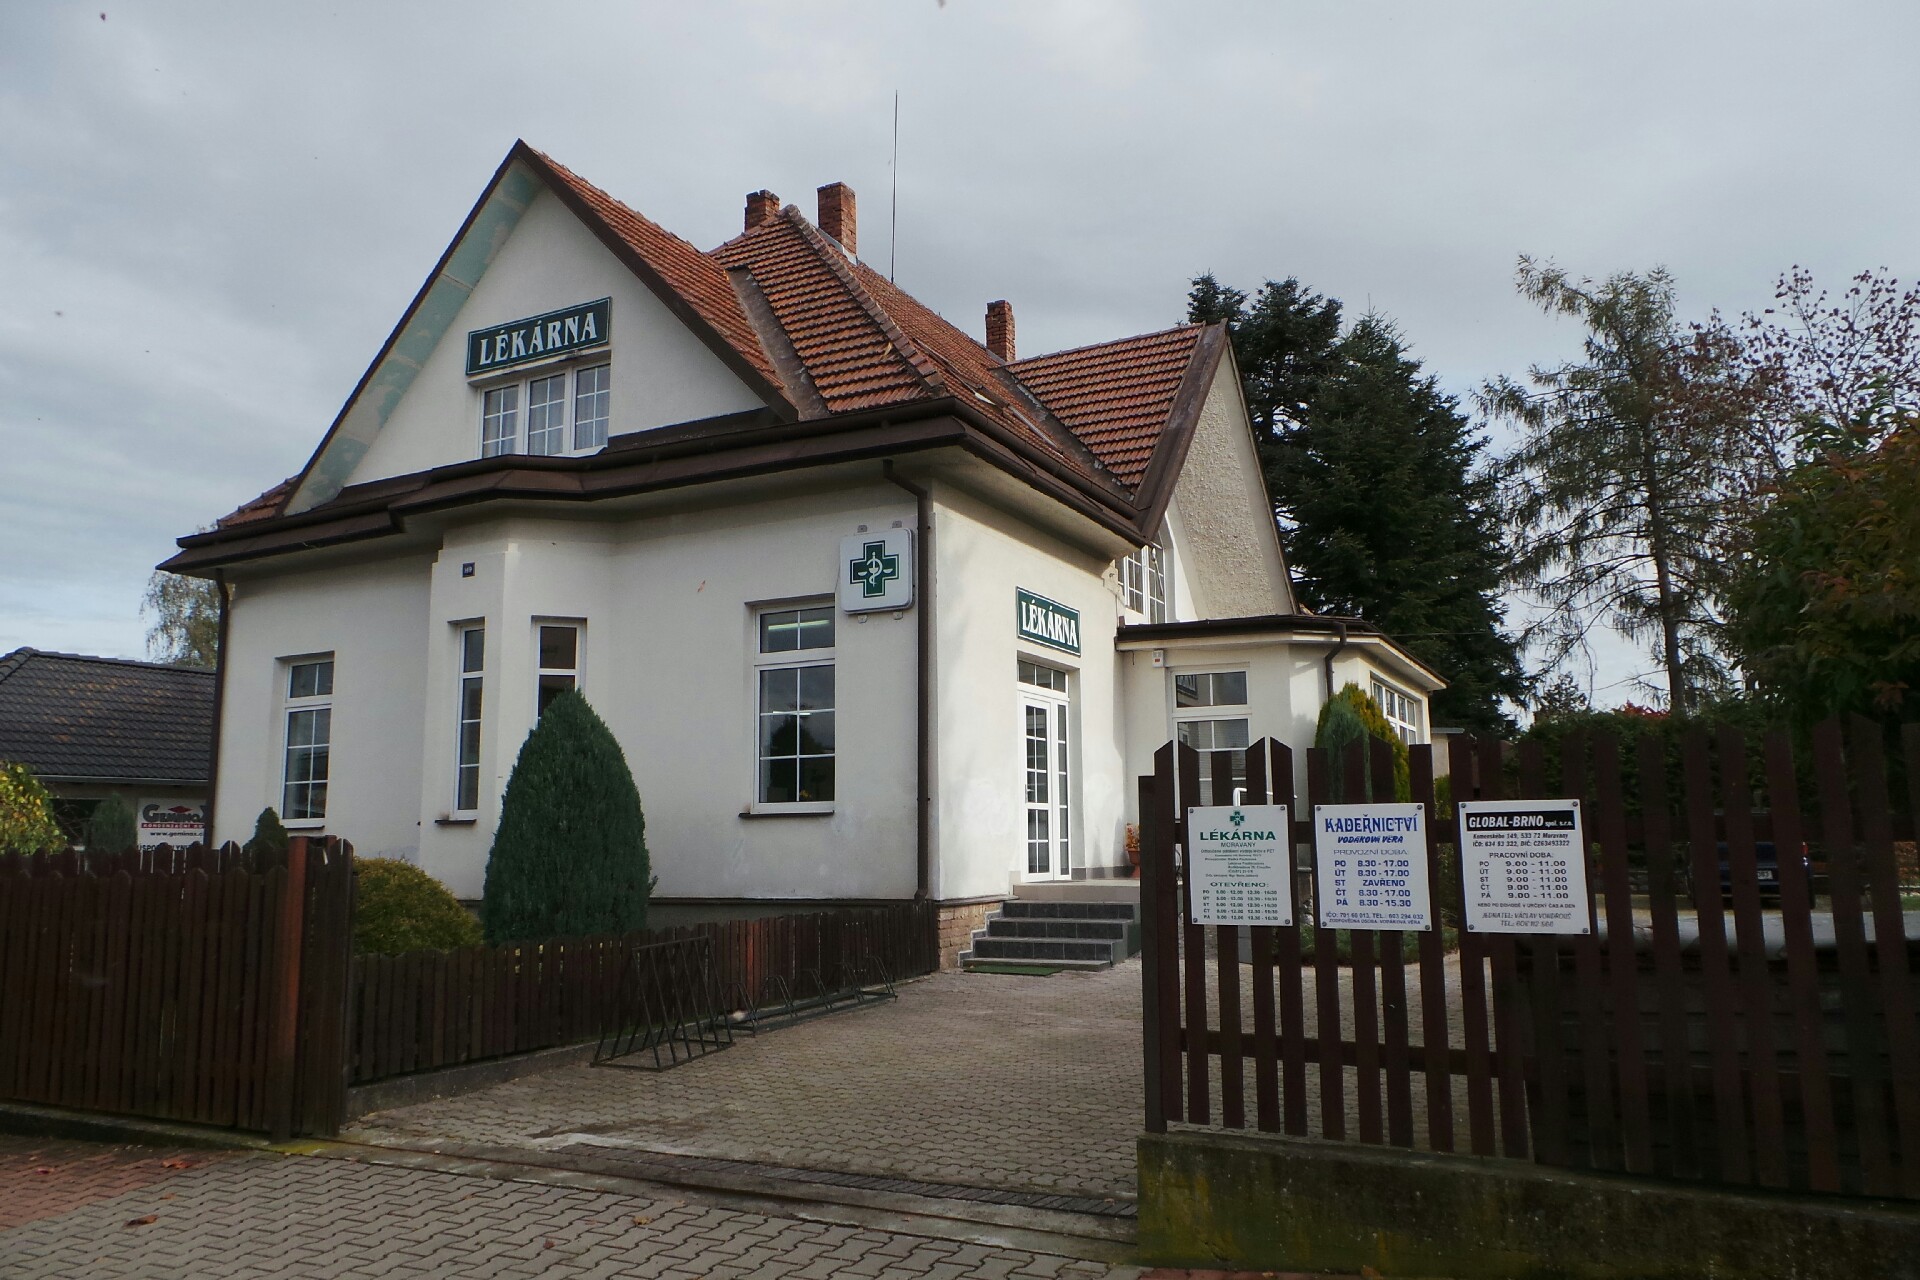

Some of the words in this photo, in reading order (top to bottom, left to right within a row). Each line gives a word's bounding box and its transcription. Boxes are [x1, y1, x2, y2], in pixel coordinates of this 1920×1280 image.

[478, 312, 597, 366] LÉKÁRNA
[1021, 598, 1079, 648] LÉKÁRNA
[1325, 814, 1418, 833] KADEŘNICTVÍ
[1469, 815, 1544, 828] GLOBAL-BRNO
[1200, 829, 1276, 840] LÉKÁRNA
[1338, 835, 1380, 843] VODÁKOVÁ
[1382, 835, 1404, 843] VĚRA
[1363, 878, 1406, 887] ZAVŘENO
[1336, 888, 1346, 896] ČT
[1336, 898, 1348, 906] PÁ
